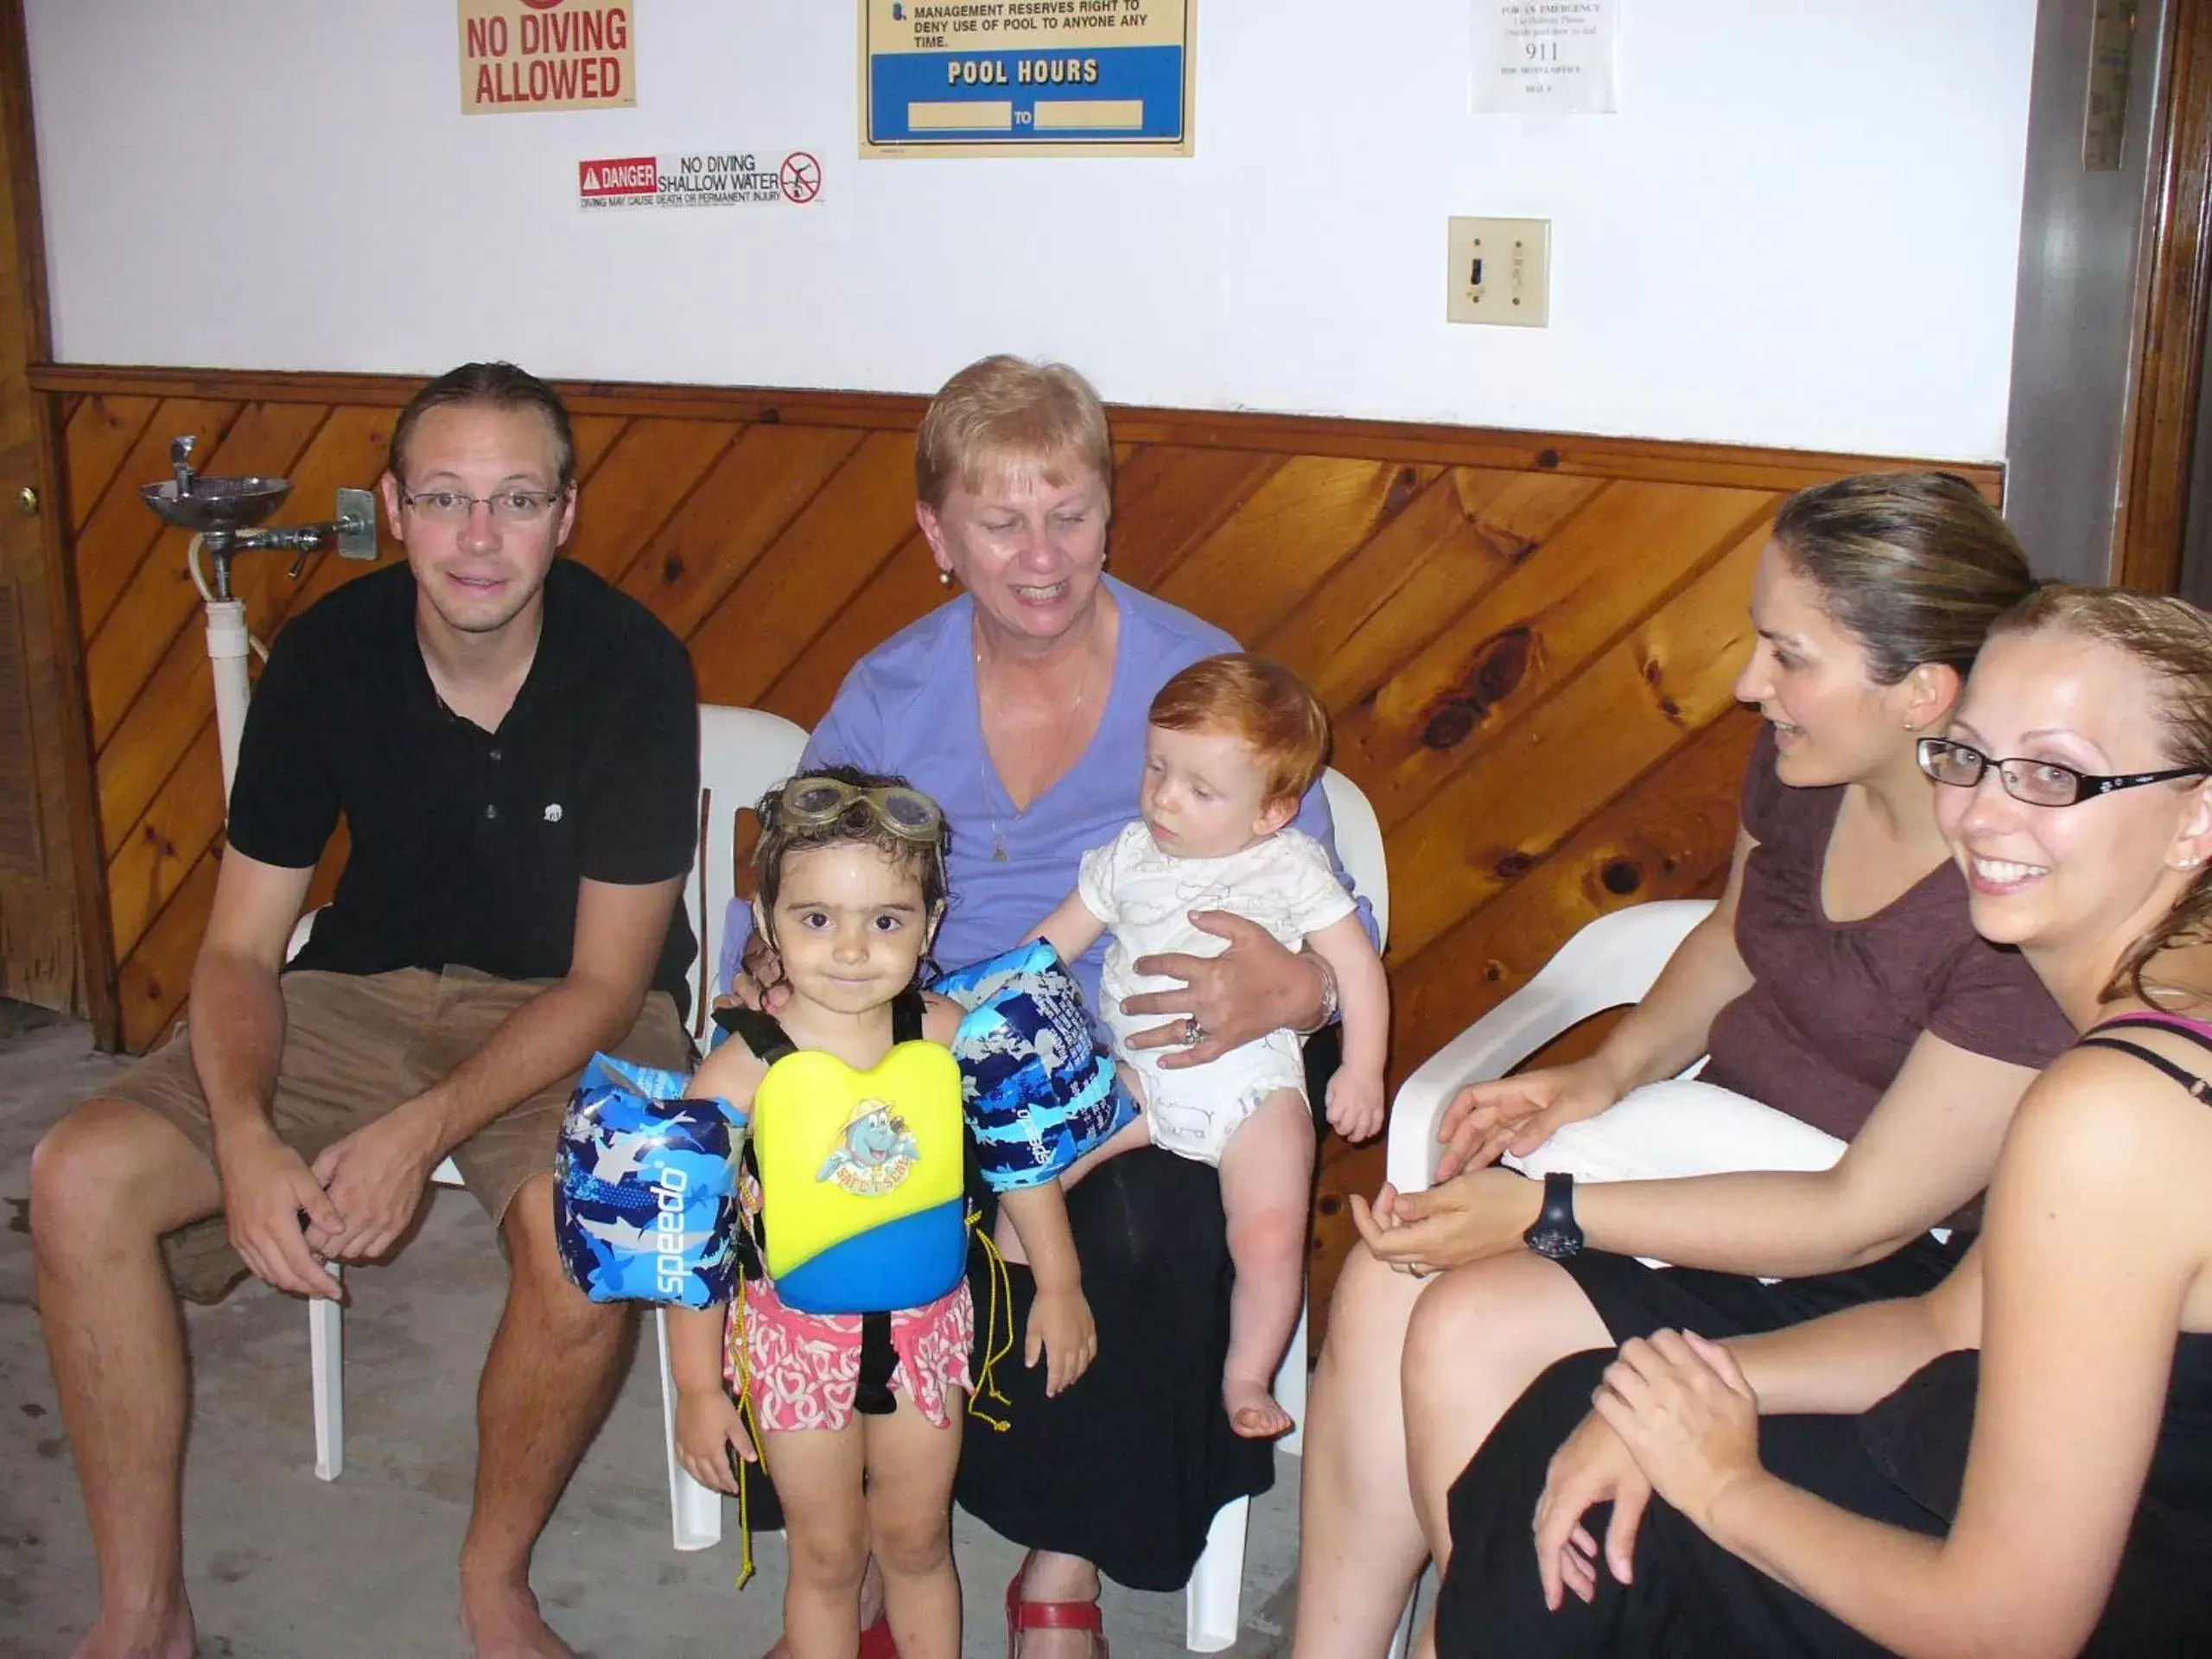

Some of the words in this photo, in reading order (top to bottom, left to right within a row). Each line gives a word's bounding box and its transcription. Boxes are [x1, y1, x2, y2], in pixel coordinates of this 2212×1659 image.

[914, 3, 1003, 18] MANAGEMENT
[1008, 2, 1074, 15] RESERVES
[1079, 0, 1118, 12] RIGHT
[1124, 0, 1140, 10] TO
[1539, 3, 1601, 14] EMERGENCY
[467, 16, 508, 58] NO
[520, 8, 626, 54] DIVING
[914, 21, 948, 33] DENY
[953, 20, 977, 32] USE
[982, 19, 1000, 31] OF
[1003, 18, 1037, 30] POOL
[1043, 17, 1058, 29] TO
[1062, 15, 1116, 29] ANYONE
[1121, 14, 1147, 27] ANY
[914, 36, 948, 48] TIME.
[1525, 41, 1558, 61] 911
[475, 57, 620, 104] ALLOWED
[948, 60, 1008, 86] POOL
[1018, 59, 1099, 85] HOURS
[1014, 111, 1032, 124] TO
[681, 156, 702, 174] NO
[708, 155, 755, 173] DIVING
[602, 164, 655, 188] DANGER
[658, 175, 728, 193] SHALLOW
[730, 173, 779, 190] WATER
[581, 197, 607, 207] DIVING
[608, 196, 625, 207] MAY
[627, 195, 654, 206] CAUSE
[657, 194, 683, 205] DEATH
[684, 193, 696, 204] OR
[699, 191, 751, 203] PERMANENT
[753, 190, 781, 201] INJURY
[650, 1166, 693, 1294] speedo
